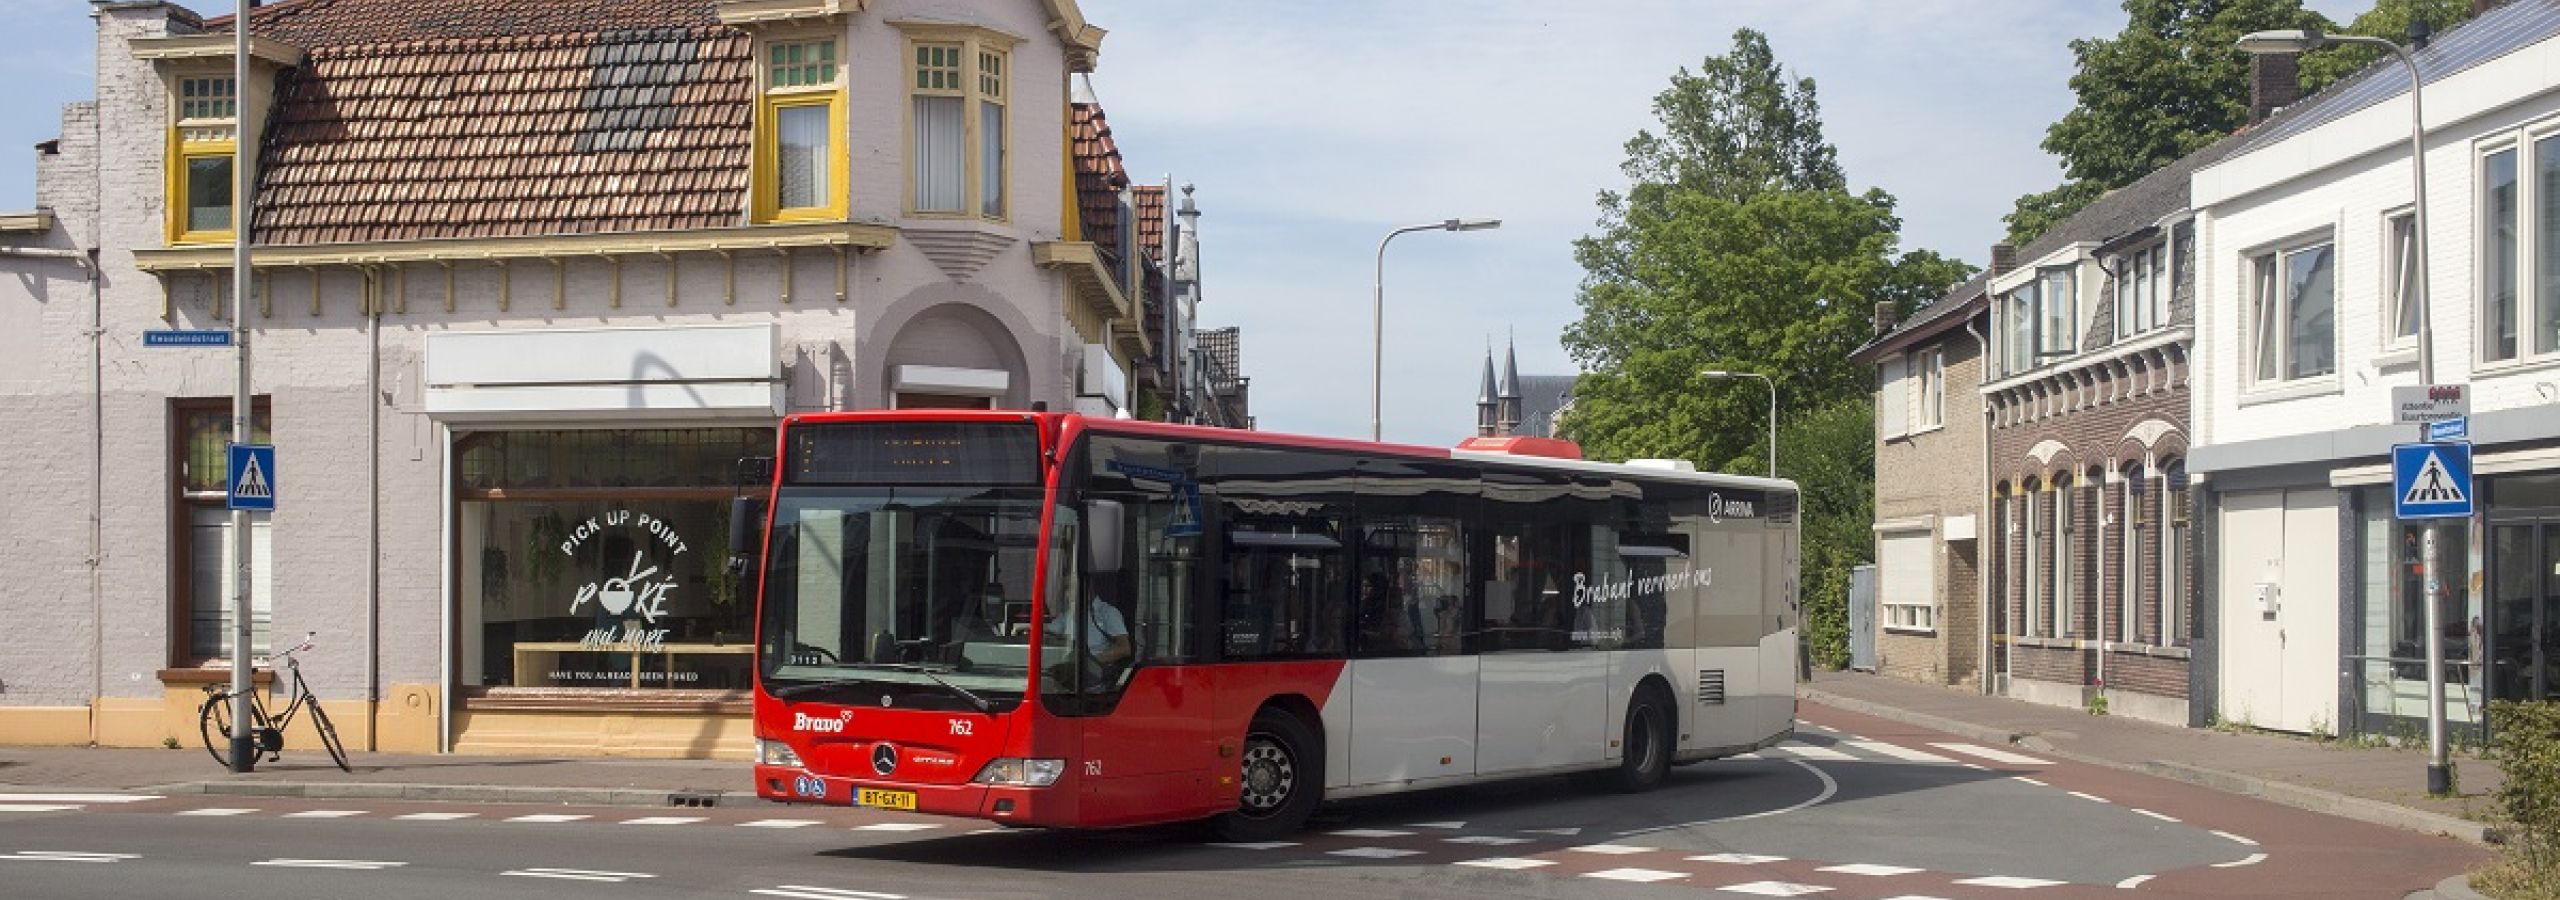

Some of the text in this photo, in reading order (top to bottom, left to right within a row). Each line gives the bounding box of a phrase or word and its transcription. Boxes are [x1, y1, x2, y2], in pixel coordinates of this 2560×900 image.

[1723, 499, 1755, 518] ARRIVA
[560, 509, 688, 556] PICK UP POINT
[1572, 561, 1712, 608] Brabant vervoert ons
[548, 671, 573, 681] HAVE
[575, 671, 592, 681] YOU
[640, 671, 664, 681] BEEN
[793, 712, 844, 733] Bravo
[948, 718, 974, 735] 762
[1083, 759, 1102, 776] 762
